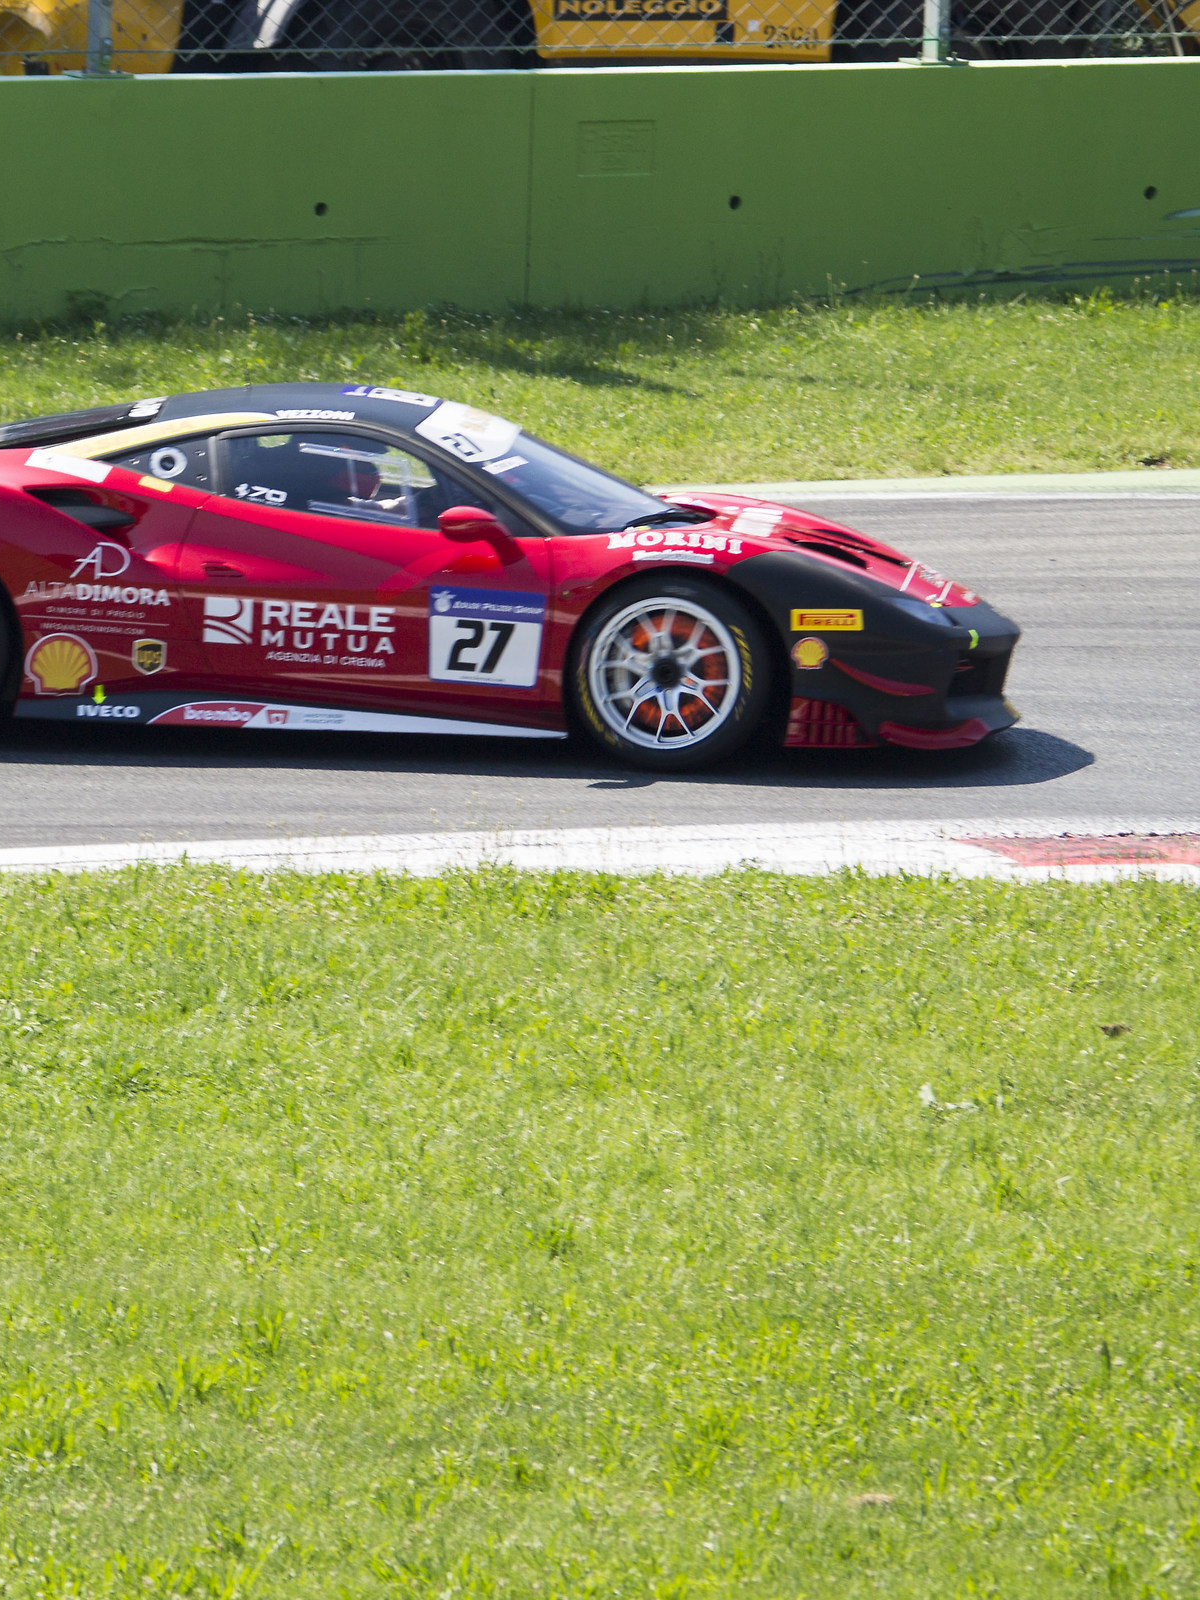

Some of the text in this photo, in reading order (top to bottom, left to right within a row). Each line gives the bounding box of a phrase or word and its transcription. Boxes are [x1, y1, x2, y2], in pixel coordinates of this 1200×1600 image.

[557, 0, 722, 14] NOLEGGIO
[607, 531, 744, 555] MORINI
[23, 580, 171, 607] ALTADIMORA
[261, 600, 397, 633] REALE
[798, 613, 856, 627] PIRELLI
[261, 629, 396, 655] MUTUA
[446, 619, 516, 674] 27
[265, 651, 387, 669] AGENZIA DI CREMA
[76, 703, 141, 719] IVECO
[183, 706, 252, 722] brembo
